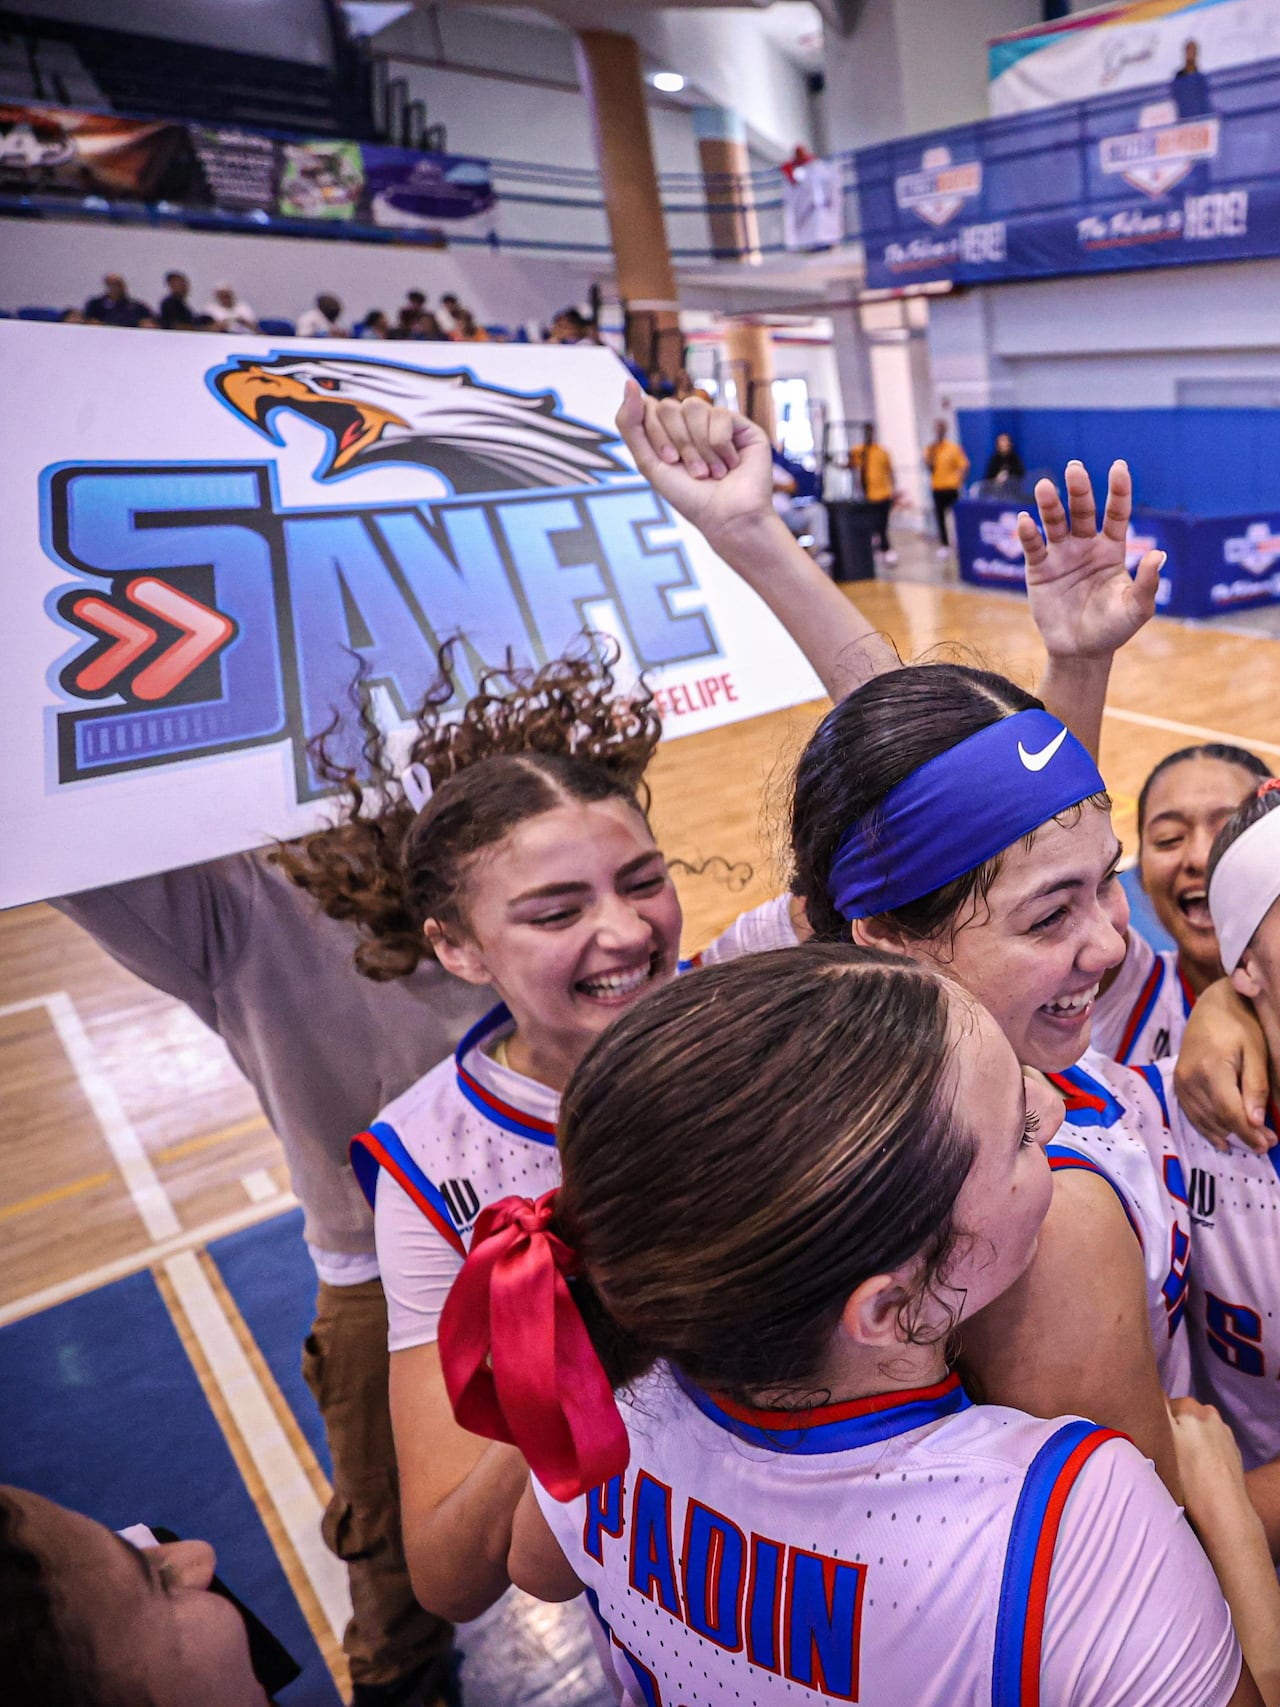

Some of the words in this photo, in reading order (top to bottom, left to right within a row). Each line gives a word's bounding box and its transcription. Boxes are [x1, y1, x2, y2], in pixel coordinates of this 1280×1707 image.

[44, 460, 722, 804] SANFE
[653, 672, 739, 721] FELIPE
[583, 1467, 869, 1704] PADIN
